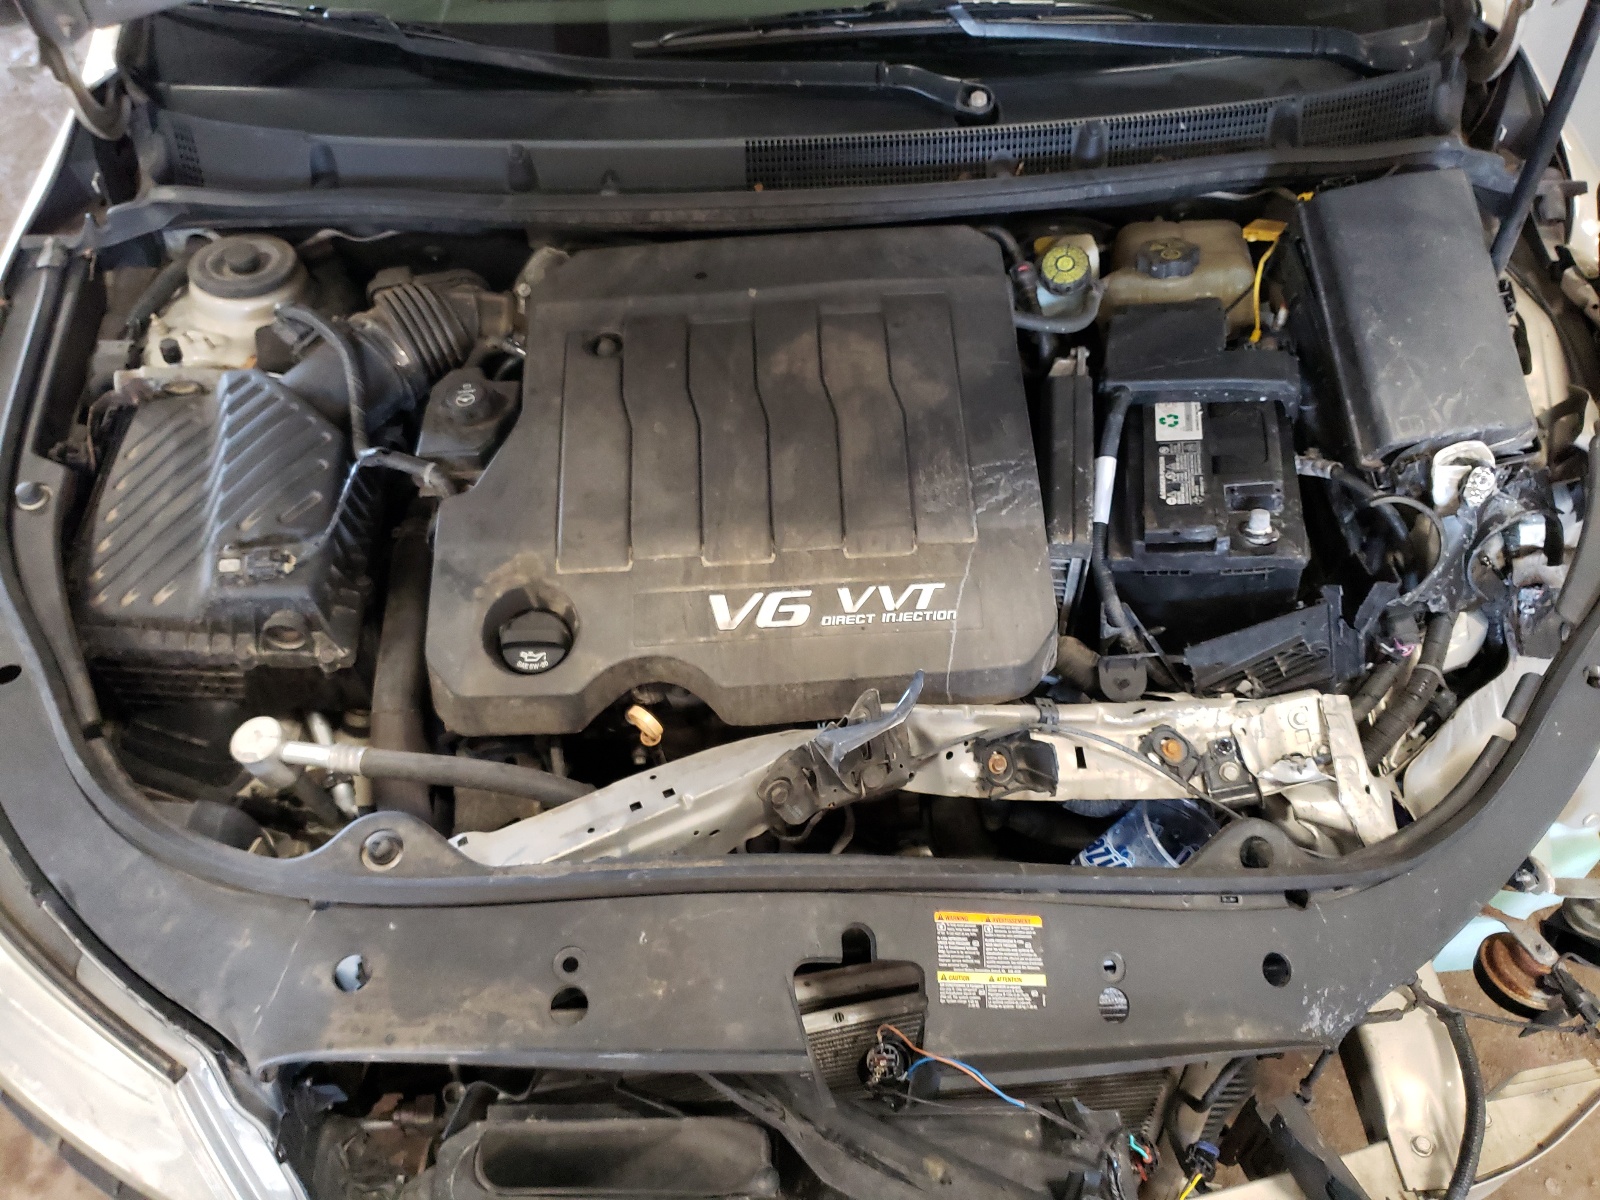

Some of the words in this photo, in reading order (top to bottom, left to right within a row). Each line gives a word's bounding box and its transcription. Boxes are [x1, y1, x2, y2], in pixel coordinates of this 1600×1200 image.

[836, 583, 946, 613] VVT
[709, 589, 812, 631] V6
[821, 613, 876, 626] DIRECT
[881, 610, 957, 623] INJECTION
[945, 914, 969, 922] WARNING
